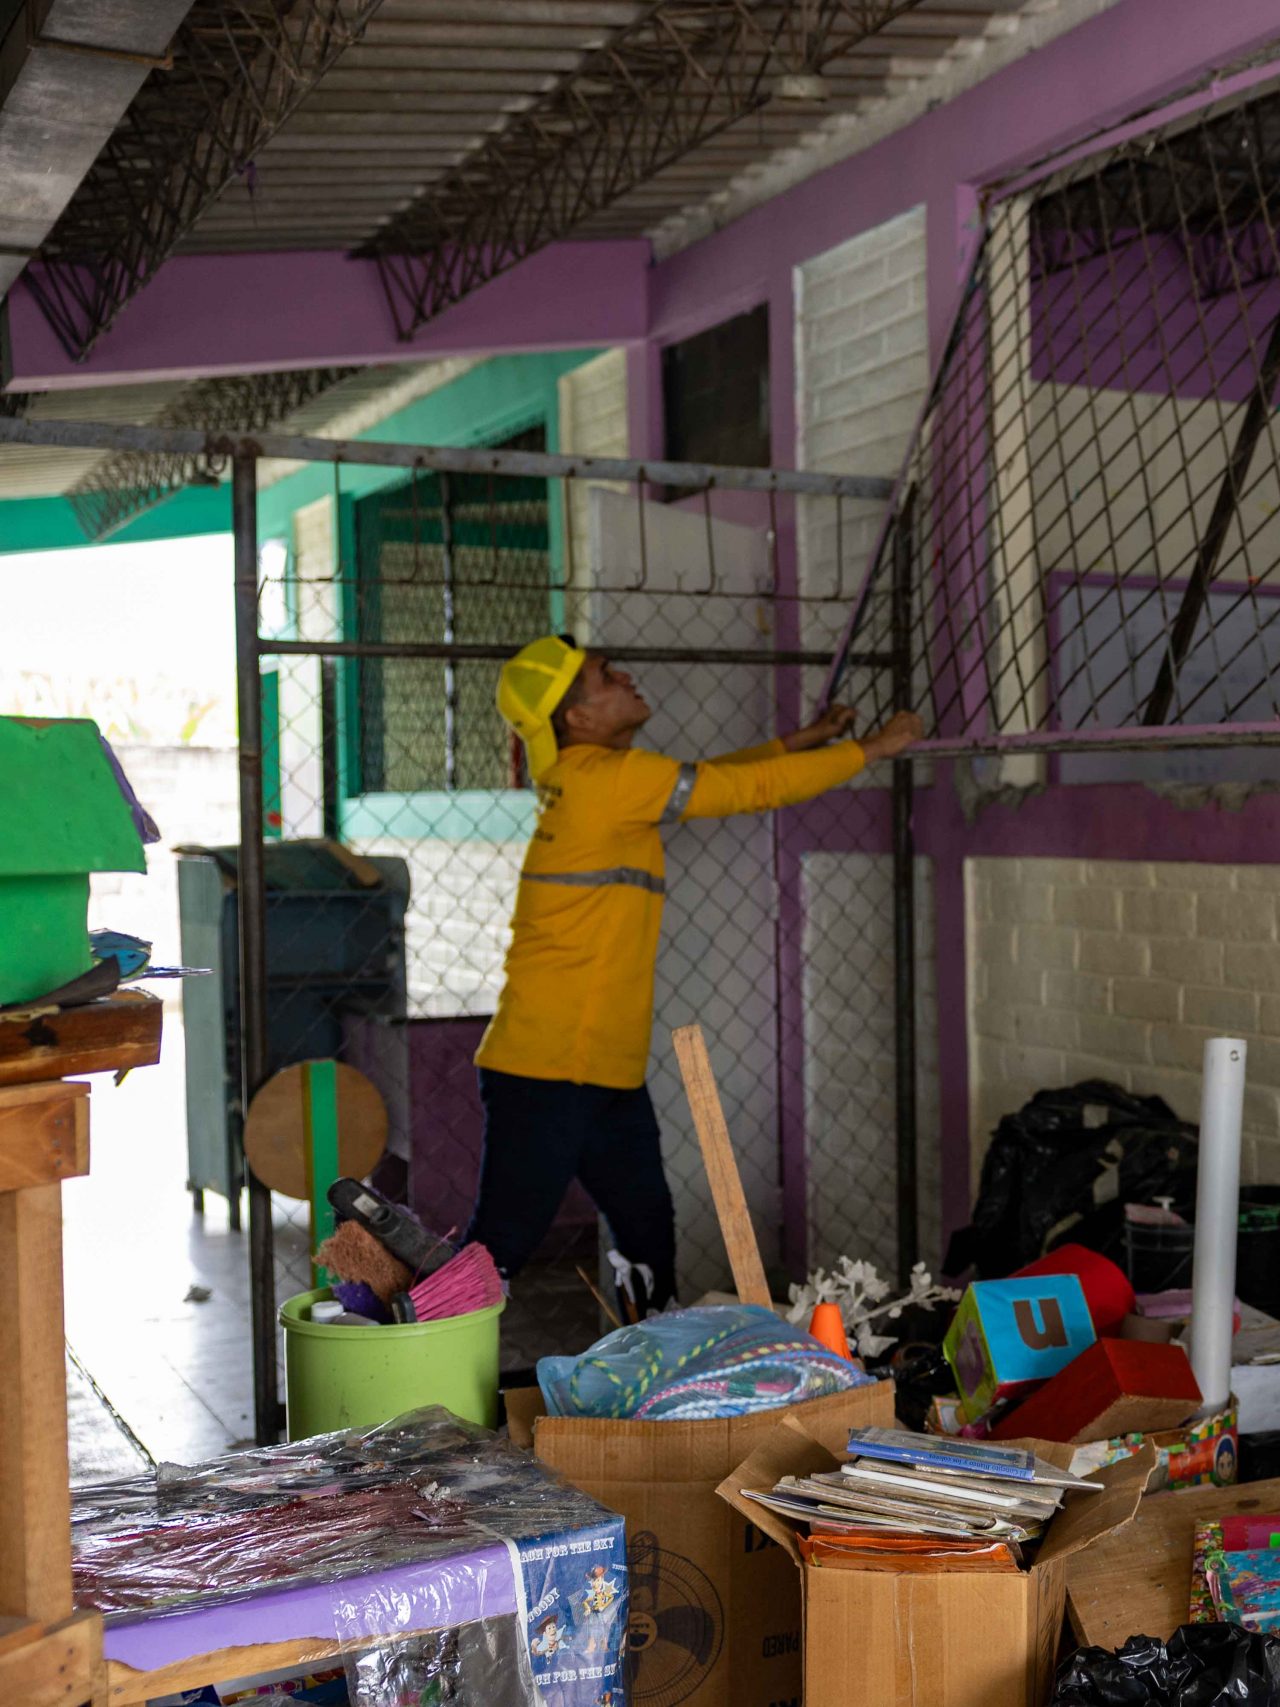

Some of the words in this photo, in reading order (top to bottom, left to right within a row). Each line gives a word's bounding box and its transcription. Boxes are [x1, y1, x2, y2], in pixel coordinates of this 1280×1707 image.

[545, 1544, 568, 1559] FOR
[570, 1541, 592, 1555] THE
[593, 1537, 615, 1551] SKY
[553, 1669, 578, 1683] FOR
[579, 1666, 603, 1680] THE
